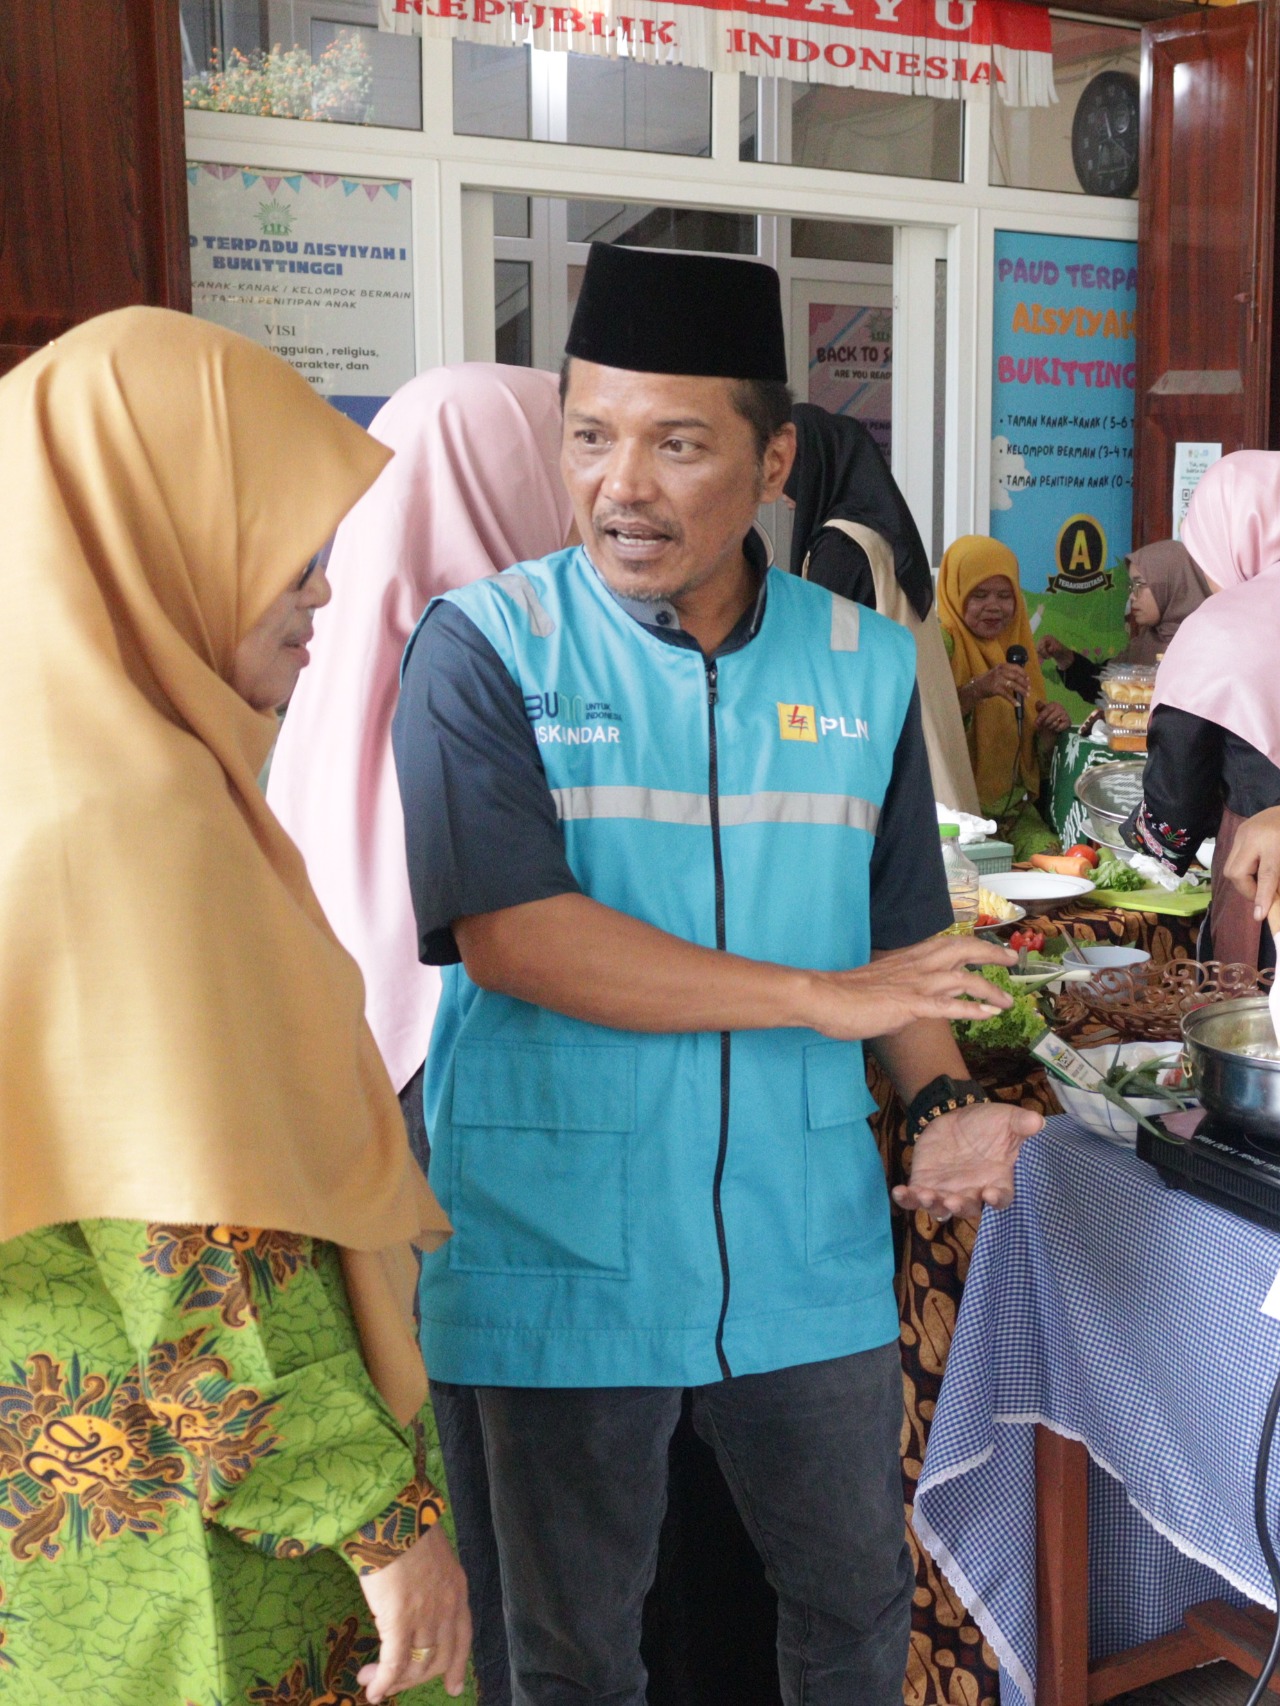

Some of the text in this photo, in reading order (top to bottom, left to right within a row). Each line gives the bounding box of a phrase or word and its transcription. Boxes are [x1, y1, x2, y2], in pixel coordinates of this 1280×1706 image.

[726, 29, 1006, 85] INDONESIA
[203, 236, 298, 254] TERPADU
[303, 242, 396, 261] AISYIYAH
[213, 256, 343, 275] BUKITTINGGI
[998, 257, 1060, 286] PAUD
[292, 286, 356, 297] KELOMPOK
[361, 289, 411, 300] BERMAIN
[258, 296, 321, 307] PENITIPAN
[325, 301, 357, 309] ANAK
[264, 324, 296, 336] VISI
[817, 346, 857, 363] BACK
[861, 346, 879, 363] TO
[346, 361, 369, 370] dan
[834, 369, 892, 380] ARE YOU READ
[1007, 415, 1038, 427] TAMAN
[1040, 415, 1101, 429] KANAK-KANAK
[1007, 444, 1054, 458] KELOMPOK
[1057, 445, 1096, 458] BERMAIN
[1007, 475, 1037, 487] TAMAN
[1040, 475, 1085, 488] PENITIPAN
[1087, 475, 1109, 488] ANAK
[1068, 529, 1092, 570] A
[585, 702, 611, 711] UNTUK
[820, 716, 870, 741] PLN
